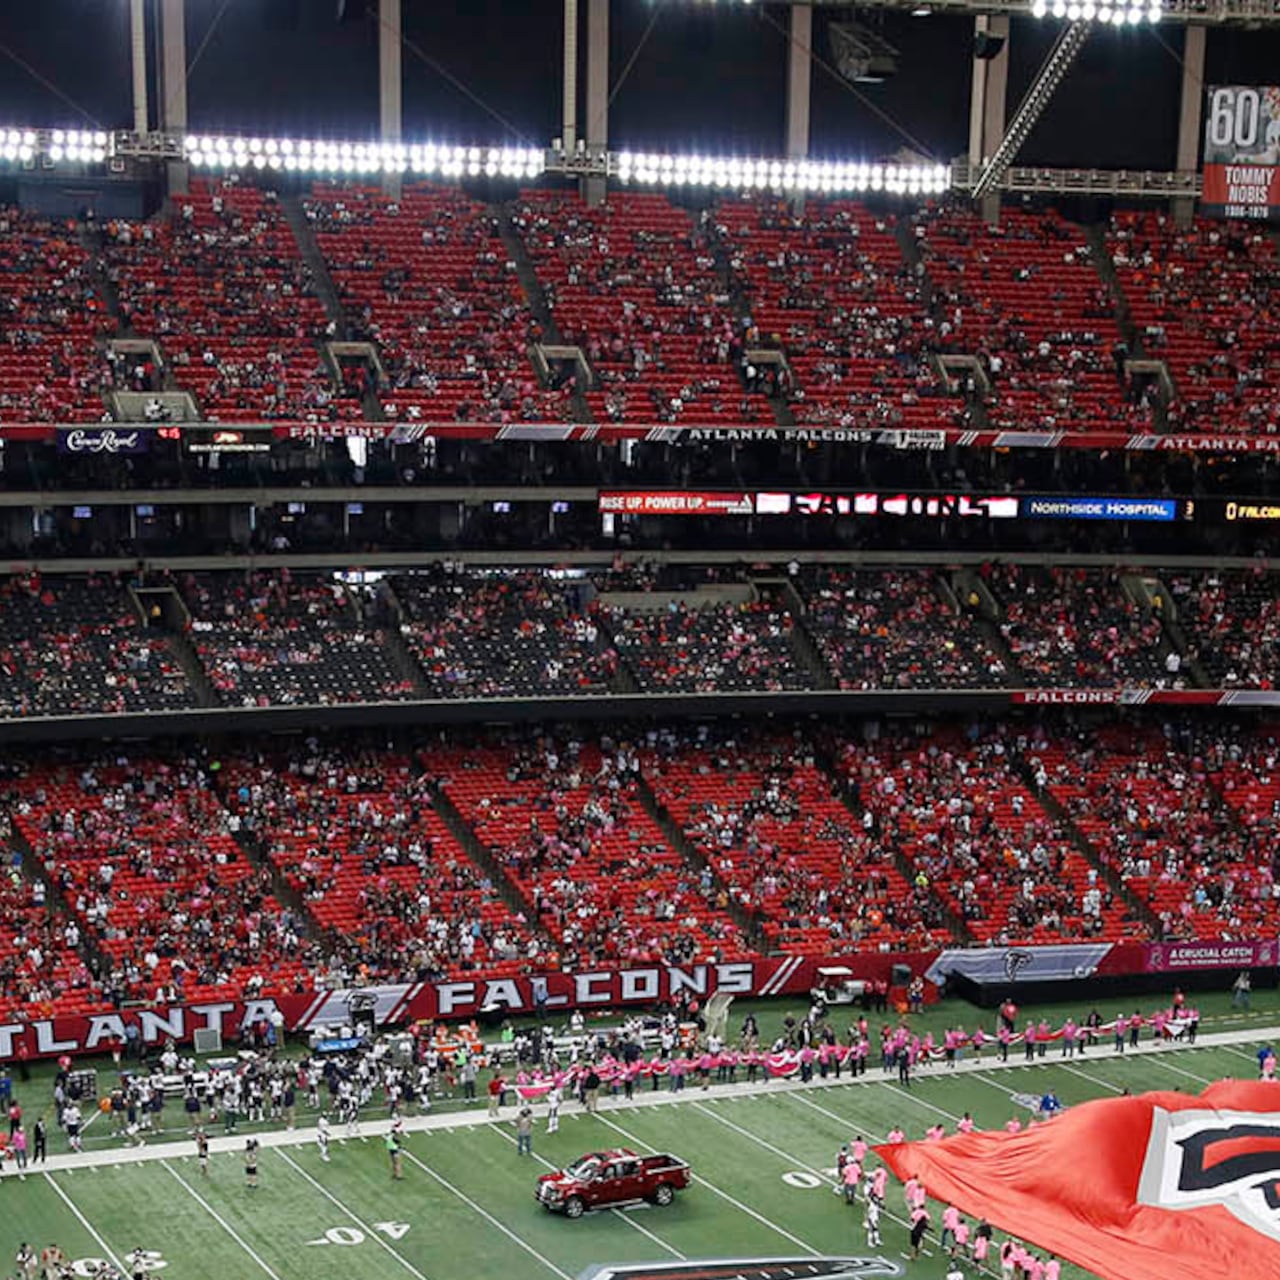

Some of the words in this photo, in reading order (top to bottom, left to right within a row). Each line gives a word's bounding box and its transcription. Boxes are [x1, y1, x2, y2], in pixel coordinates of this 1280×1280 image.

[1210, 89, 1259, 147] 60
[1224, 166, 1276, 185] TOMMY
[1228, 185, 1269, 204] NOBIS
[289, 425, 385, 439] FALCONS
[689, 428, 777, 441] ATLANTA
[784, 429, 872, 442] FALCONS
[1161, 437, 1248, 451] ATLANTA
[599, 495, 625, 510] RISE
[626, 495, 643, 510] UP.
[645, 496, 685, 510] POWER
[686, 496, 705, 510] UP.
[1030, 501, 1103, 516] NORTHSIDE
[1106, 503, 1169, 517] HOSPITAL
[1226, 502, 1236, 521] 0
[1024, 691, 1118, 704] FALCONS
[434, 960, 754, 1015] FALCONS
